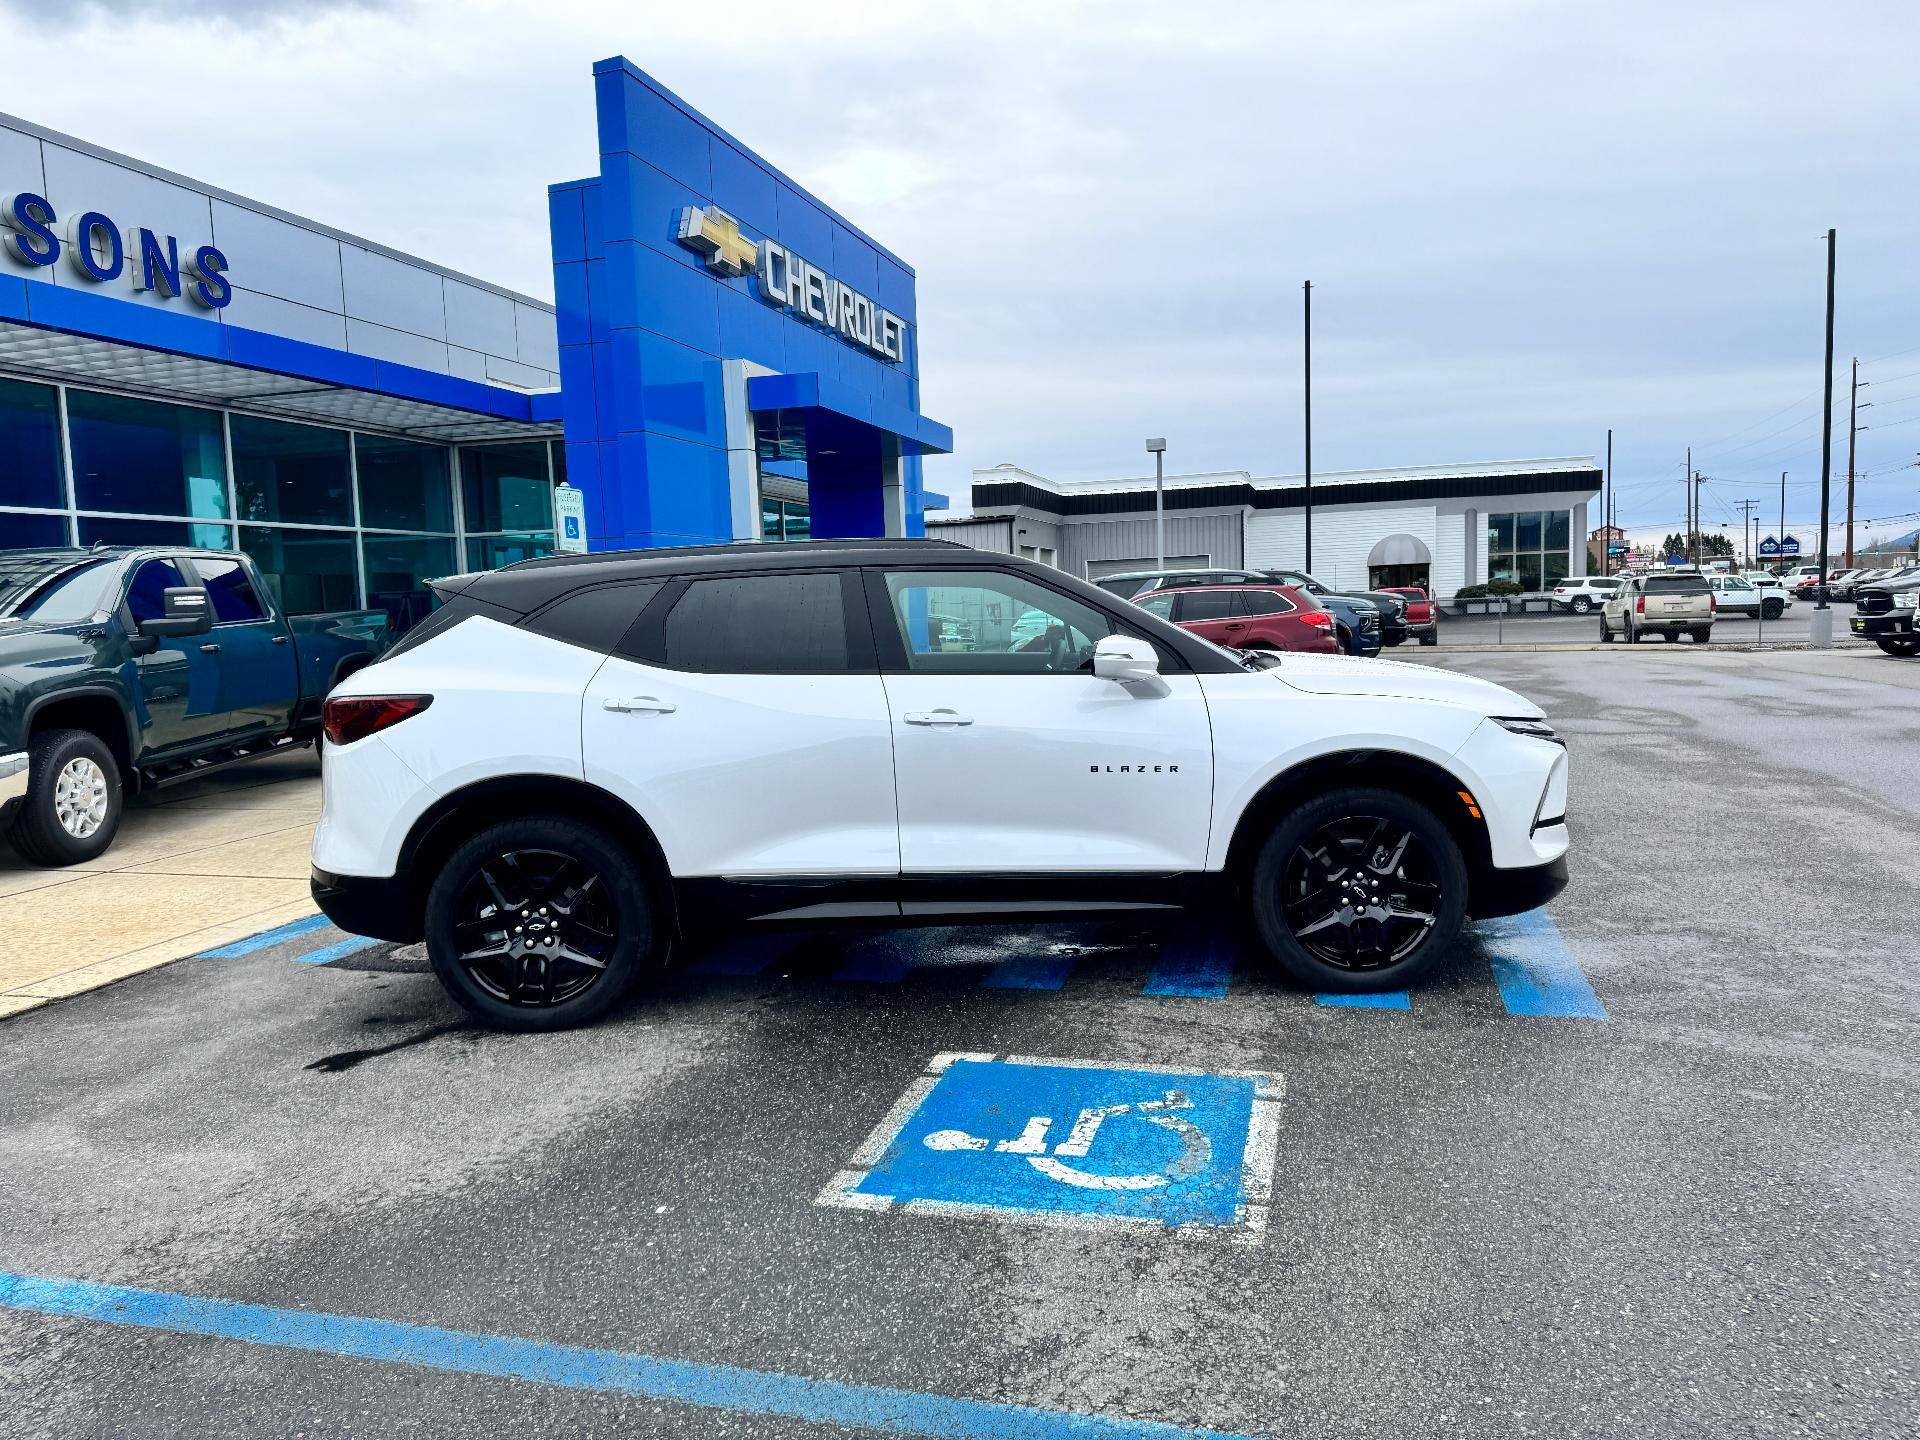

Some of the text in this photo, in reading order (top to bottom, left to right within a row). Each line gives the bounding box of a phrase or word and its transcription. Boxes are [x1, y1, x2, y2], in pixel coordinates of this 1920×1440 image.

[3, 192, 232, 309] SONS
[758, 240, 906, 363] CHEVROLET
[1090, 765, 1179, 773] BLAZER
